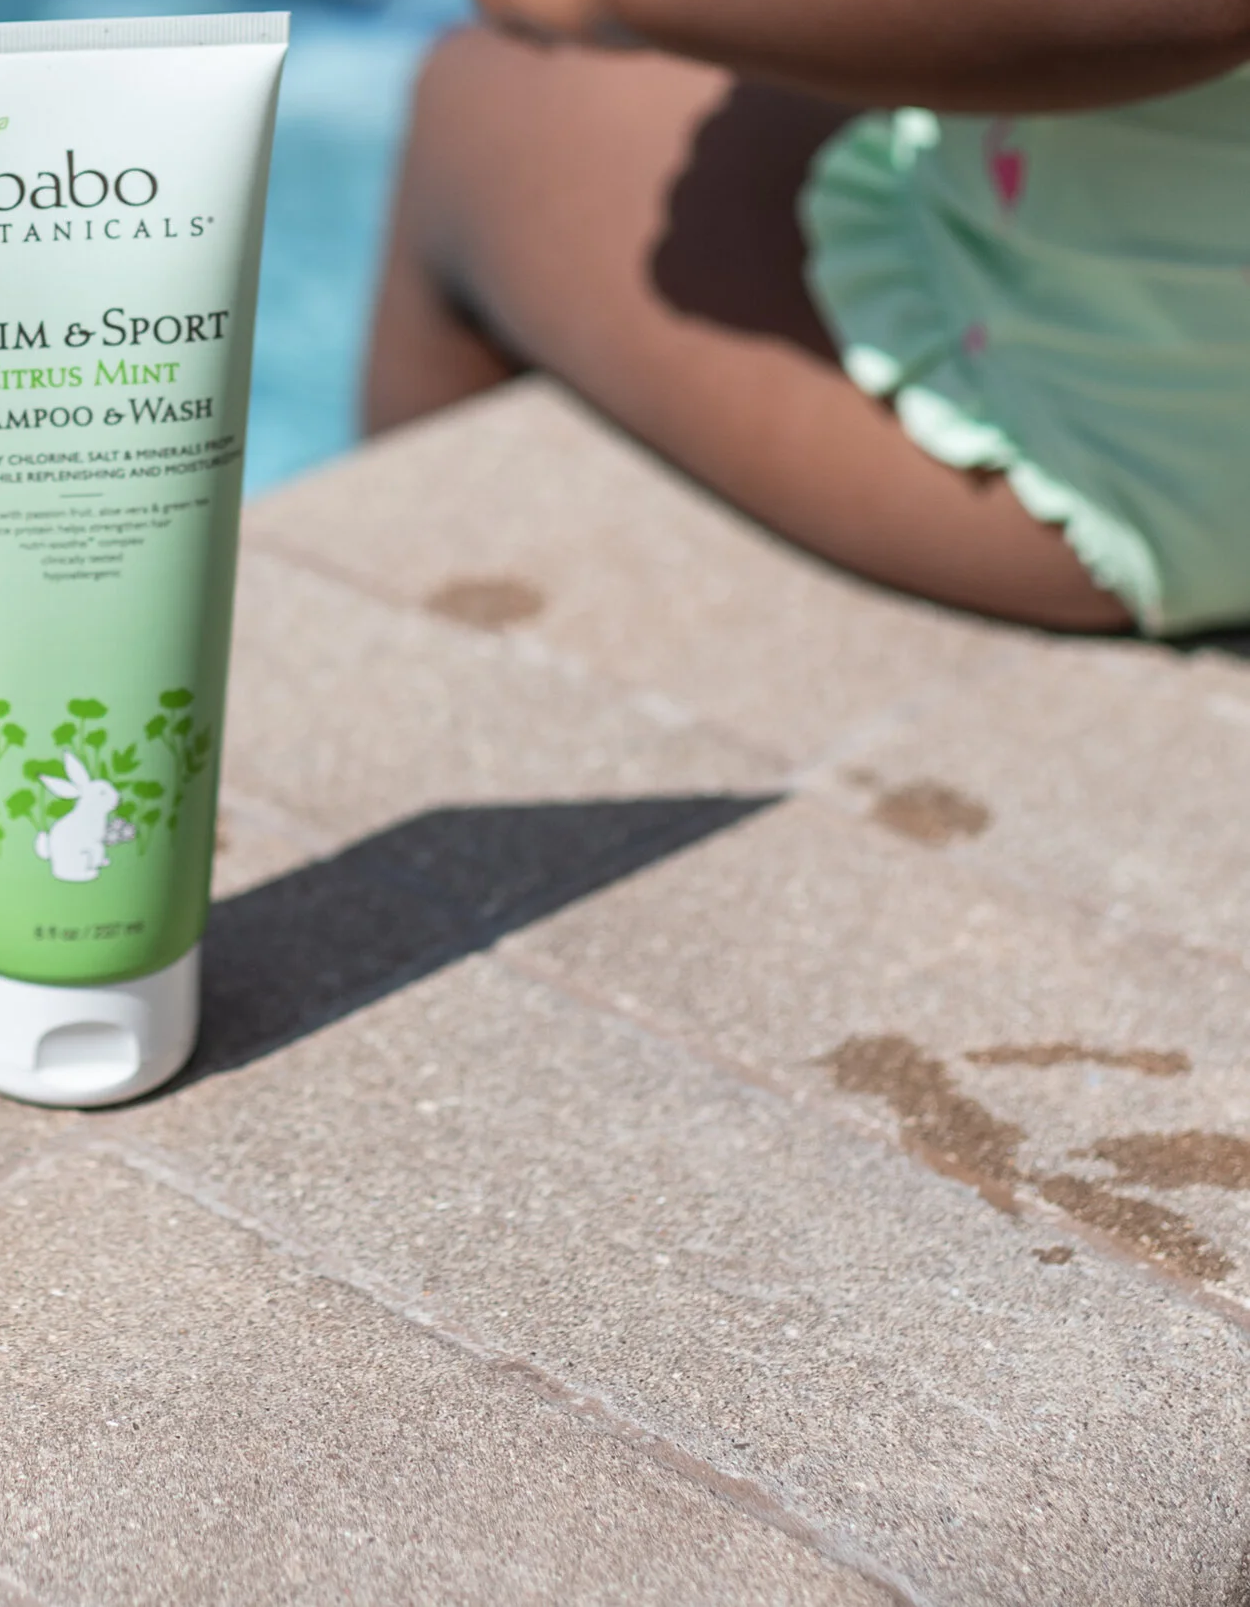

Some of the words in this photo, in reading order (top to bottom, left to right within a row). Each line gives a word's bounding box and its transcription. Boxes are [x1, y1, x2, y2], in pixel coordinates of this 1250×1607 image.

[64, 322, 96, 348] &
[103, 408, 125, 426] &
[87, 450, 119, 463] SALT
[123, 450, 133, 461] &
[136, 443, 200, 460] MINERALS
[26, 467, 126, 484] REPLENISHING
[129, 465, 161, 478] AND
